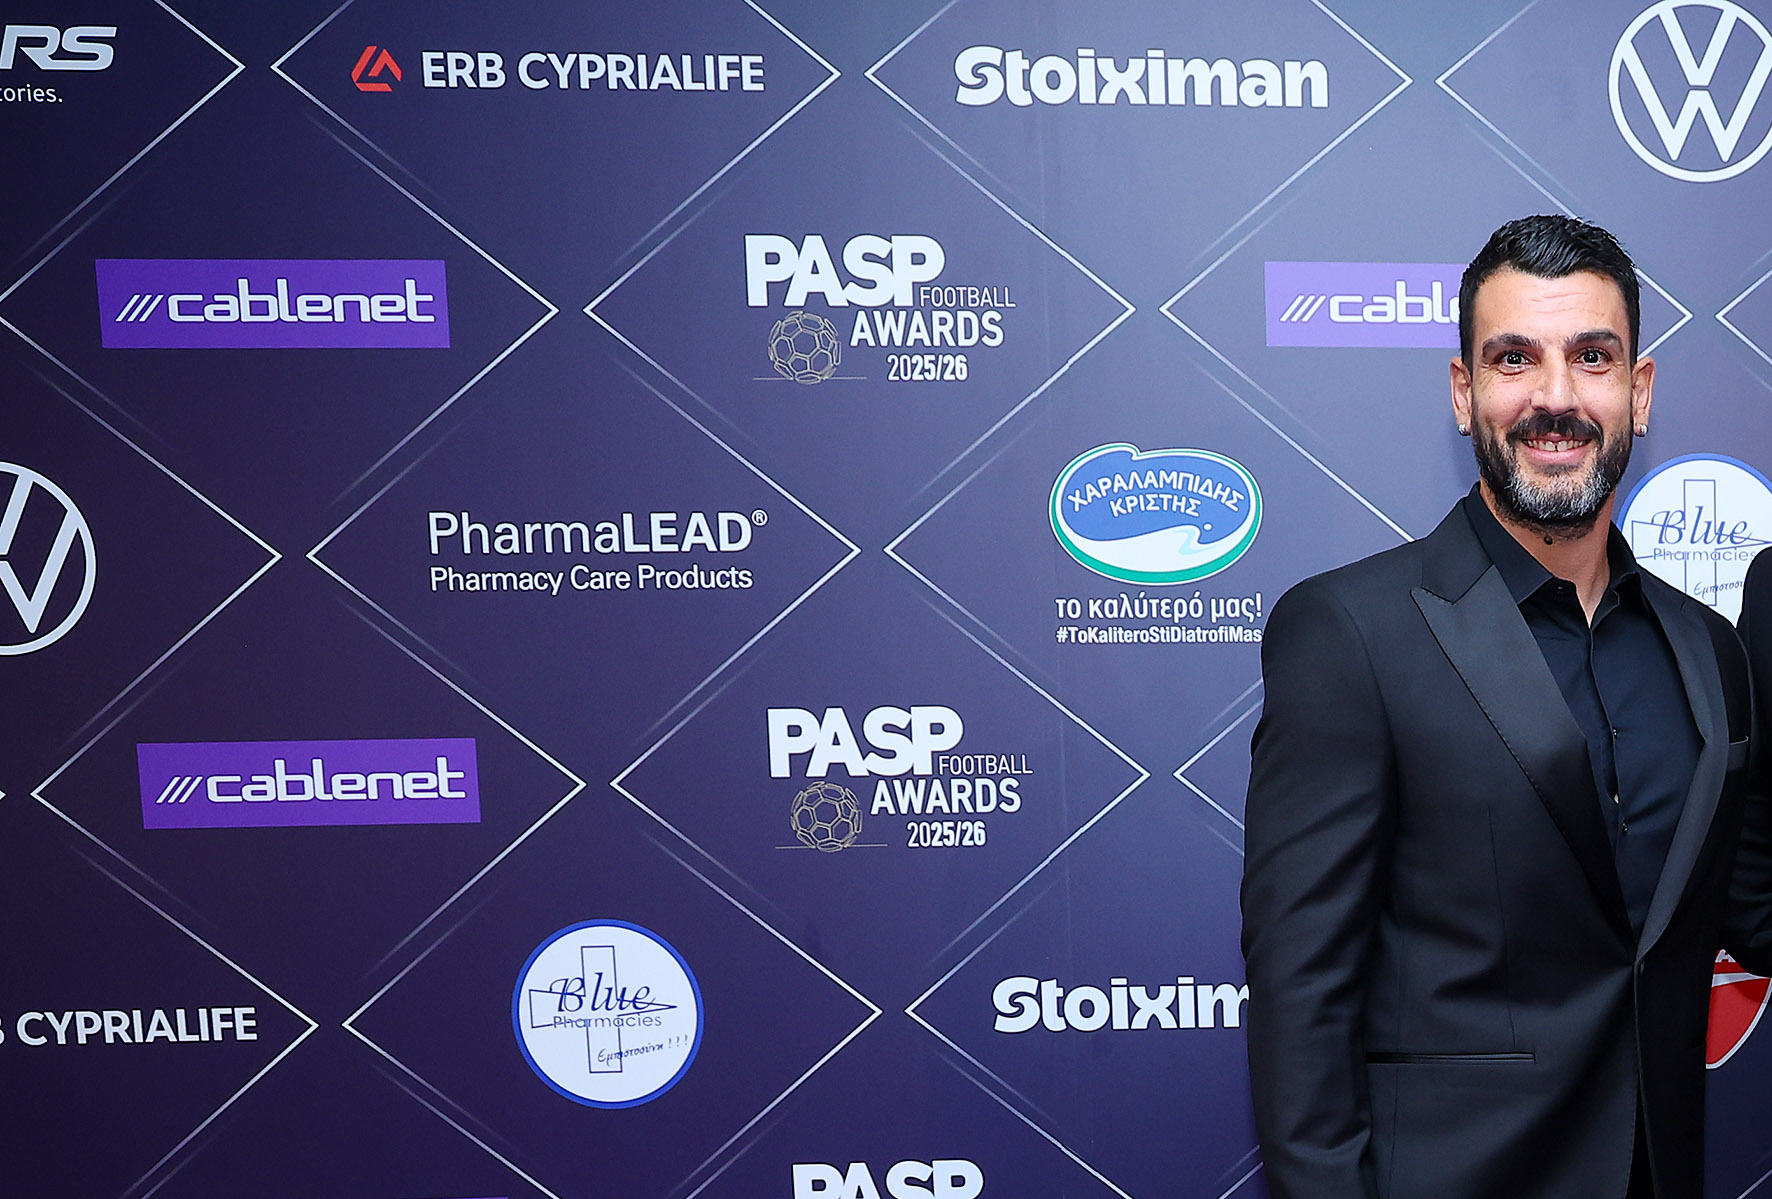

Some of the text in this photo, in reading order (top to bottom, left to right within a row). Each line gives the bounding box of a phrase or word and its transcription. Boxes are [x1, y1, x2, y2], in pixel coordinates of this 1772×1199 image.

[422, 51, 765, 91] ERB CYPRIALIFE
[954, 46, 1329, 108] Stoiximan
[0, 83, 63, 103] ories.
[745, 234, 945, 307] PASP
[167, 278, 435, 322] cablenet
[920, 286, 1017, 308] FOOTBALL
[1329, 281, 1459, 323] cabl
[850, 310, 1004, 347] AWARDS
[887, 354, 968, 381] 2025/26
[1067, 470, 1245, 512] ΧΑΡΑΛΑΜΠΙΔΗΣ
[1110, 494, 1201, 517] ΚΡΙΣΤΗΣ
[1651, 505, 1752, 545] Blue
[430, 564, 753, 596] Pharmacy Care Products
[1055, 591, 1262, 624] το καλύτερό μας!
[1056, 626, 1263, 644] #ToKaliteroStiDiatrofiMas
[767, 706, 964, 778] PASP
[206, 756, 466, 803] cablenet
[938, 754, 1034, 775] FOOTBALL
[870, 777, 1021, 815] AWARDS
[907, 820, 986, 847] 2025/26
[550, 972, 656, 1012] Blue
[992, 976, 1249, 1033] Stoixim
[16, 1006, 258, 1046] CYPRIALIFE
[553, 1015, 662, 1029] Pharmacies
